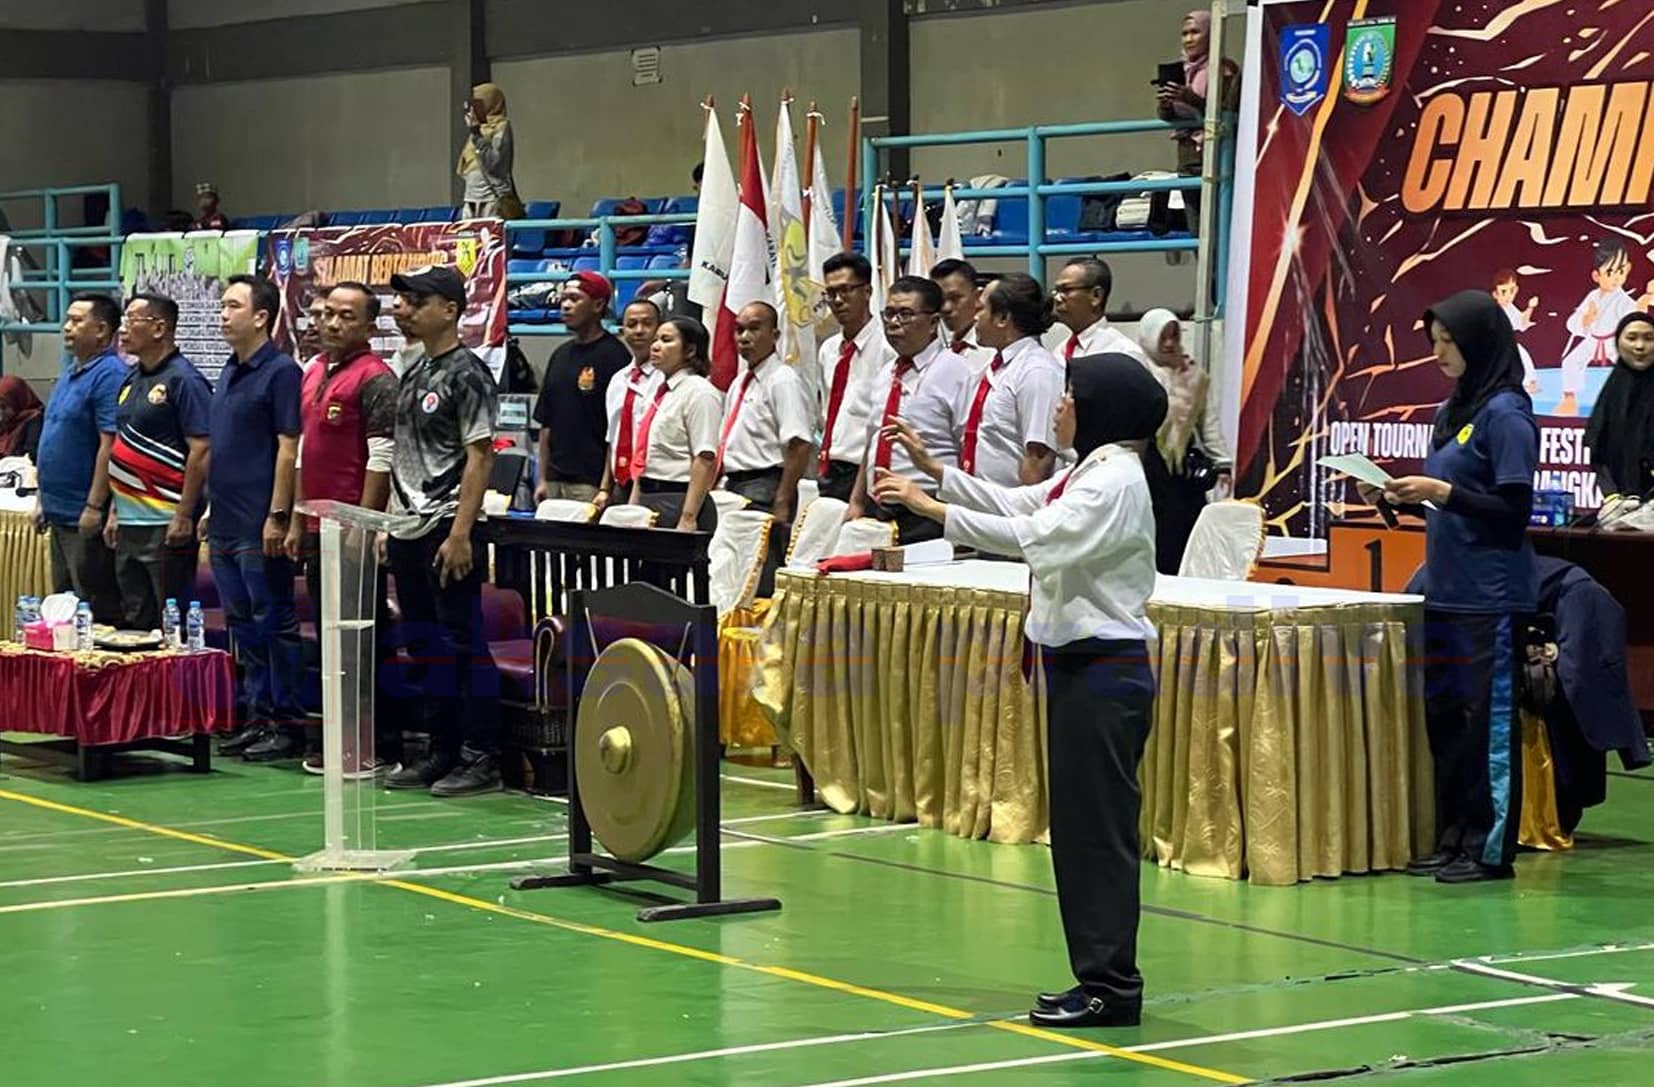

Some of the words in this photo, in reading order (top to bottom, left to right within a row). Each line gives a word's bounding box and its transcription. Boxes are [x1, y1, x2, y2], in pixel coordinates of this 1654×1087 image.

[1330, 421, 1370, 457] OPEN
[1373, 423, 1435, 459] TOURN
[1365, 539, 1383, 593] 1
